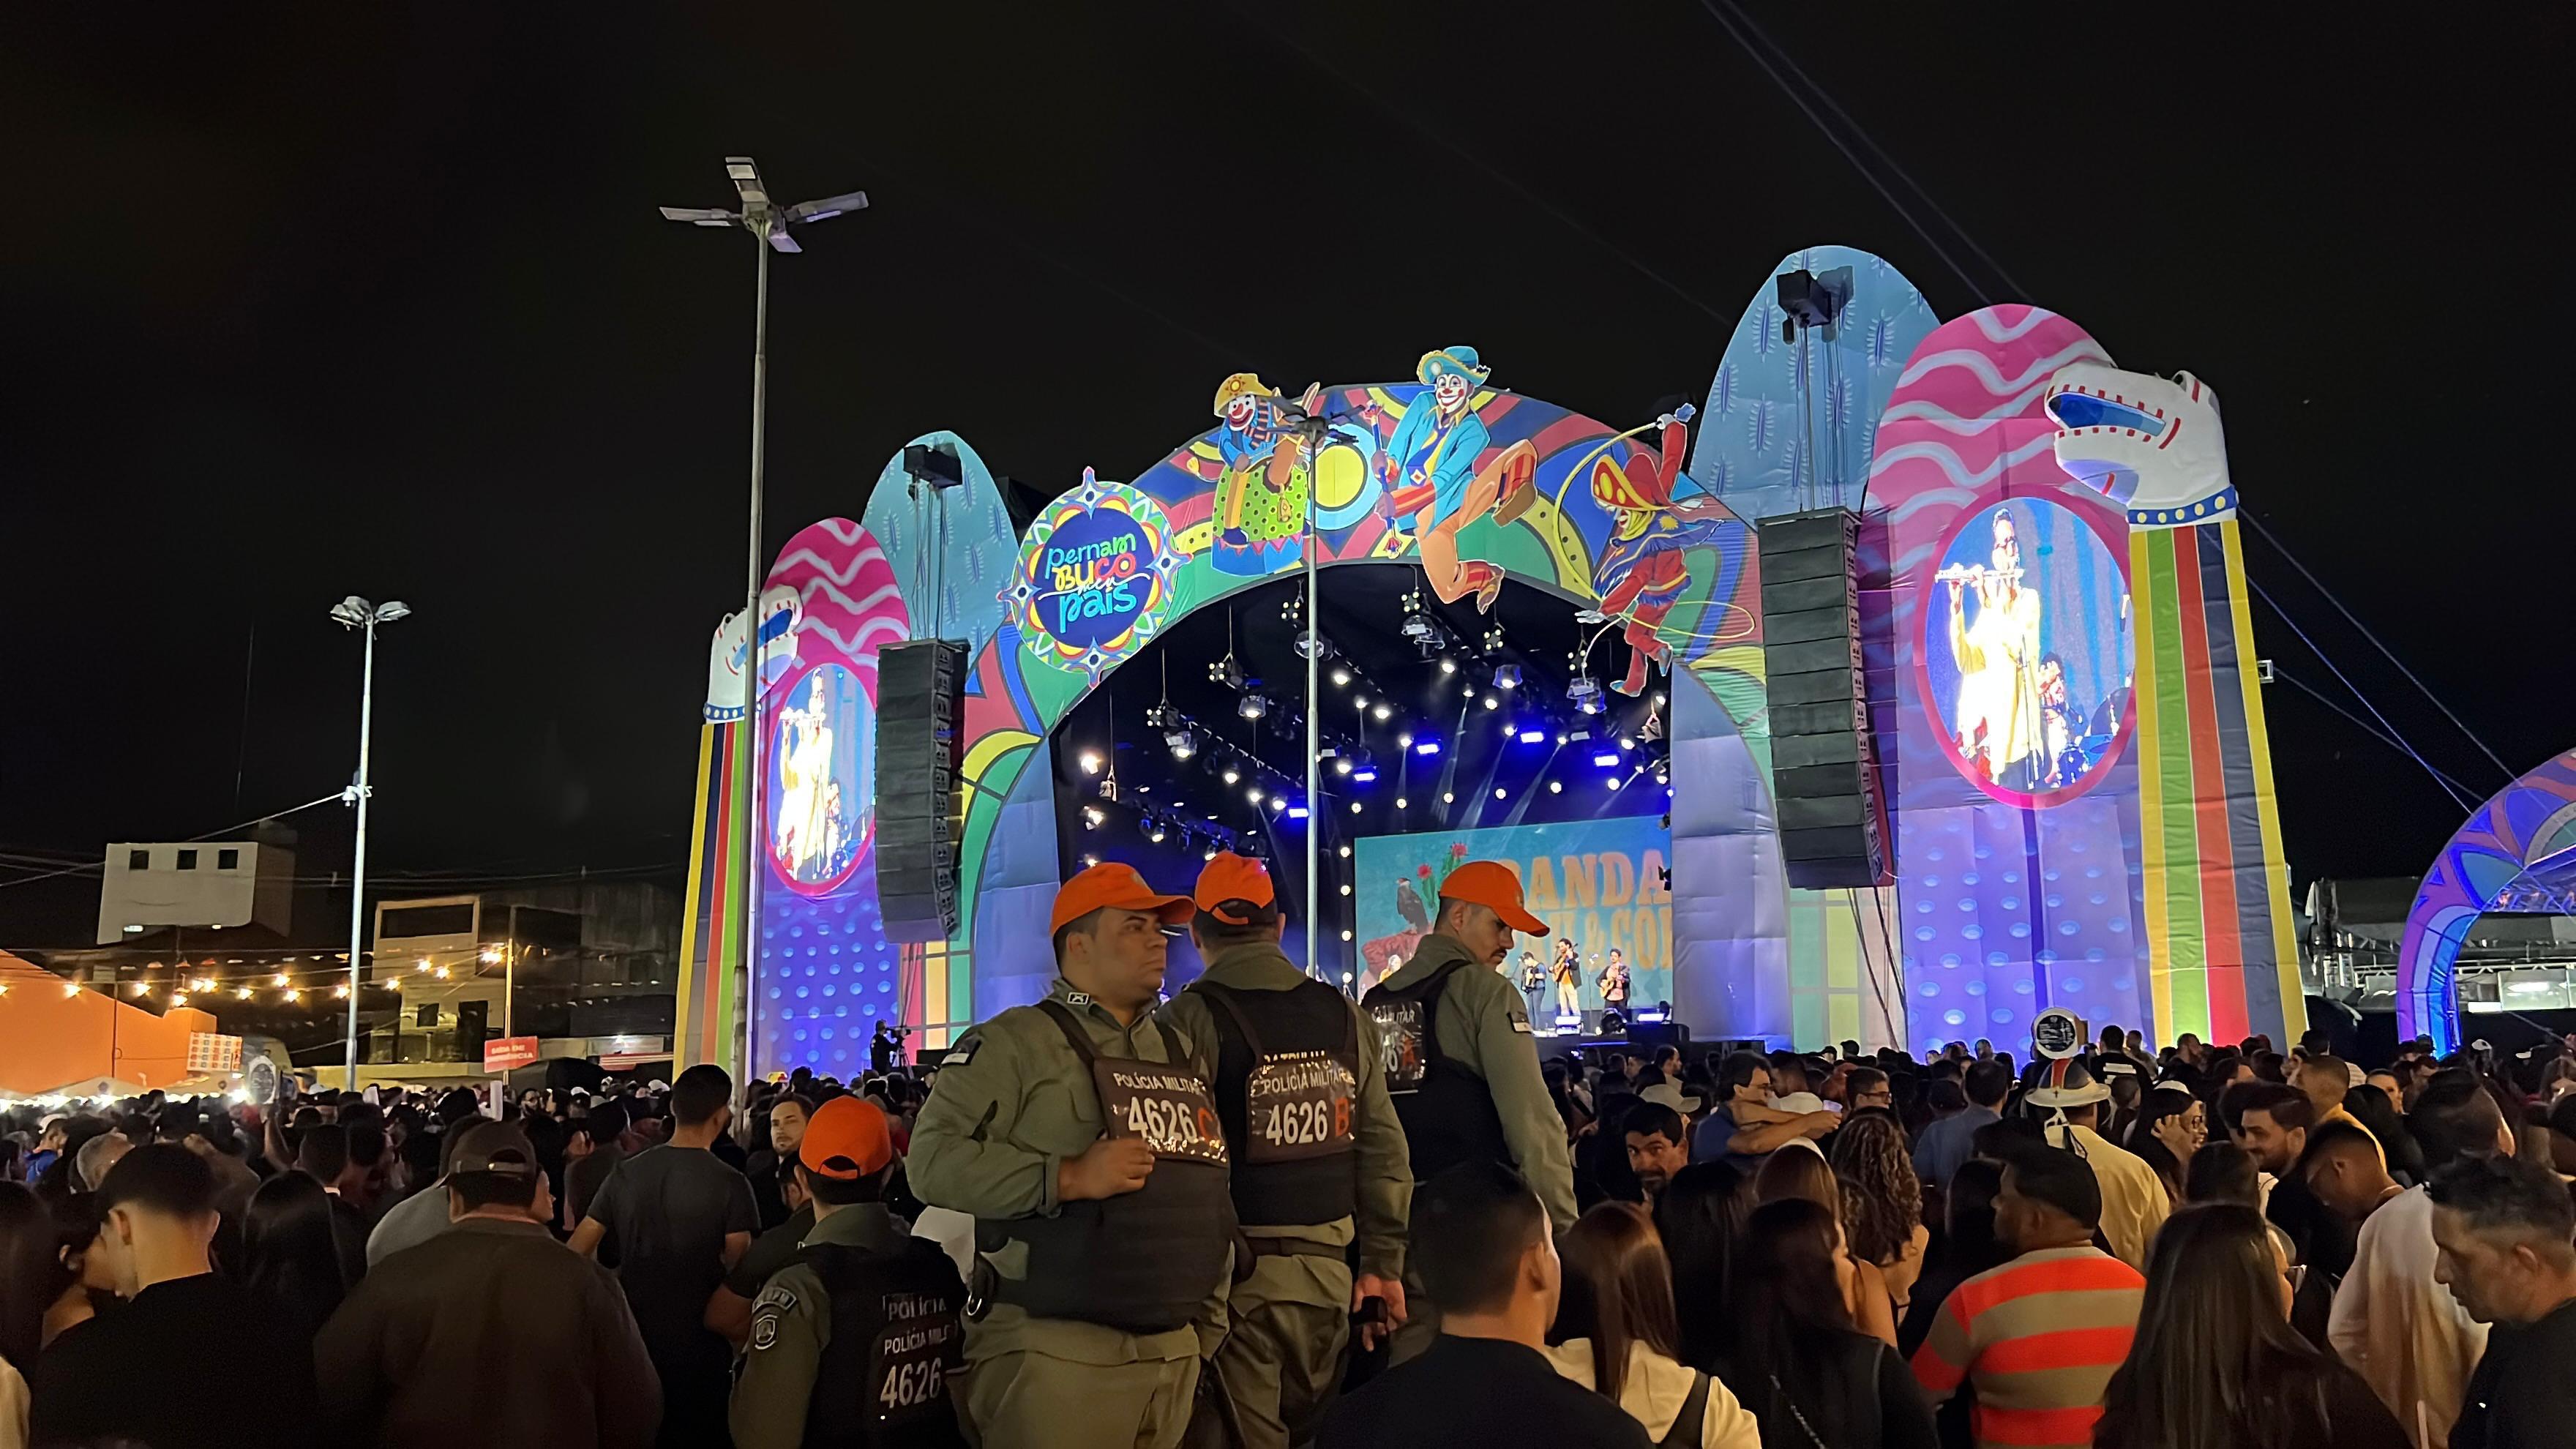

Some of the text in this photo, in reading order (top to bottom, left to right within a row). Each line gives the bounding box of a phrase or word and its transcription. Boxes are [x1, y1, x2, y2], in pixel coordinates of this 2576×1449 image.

[1500, 849, 1672, 912] ANDA
[1113, 1072, 1164, 1090] POLÍCIA
[1262, 1068, 1309, 1094] POLÍCIA
[1128, 1096, 1199, 1144] 4626
[1266, 1097, 1349, 1146] 4626 B
[880, 1358, 942, 1409] 4626
